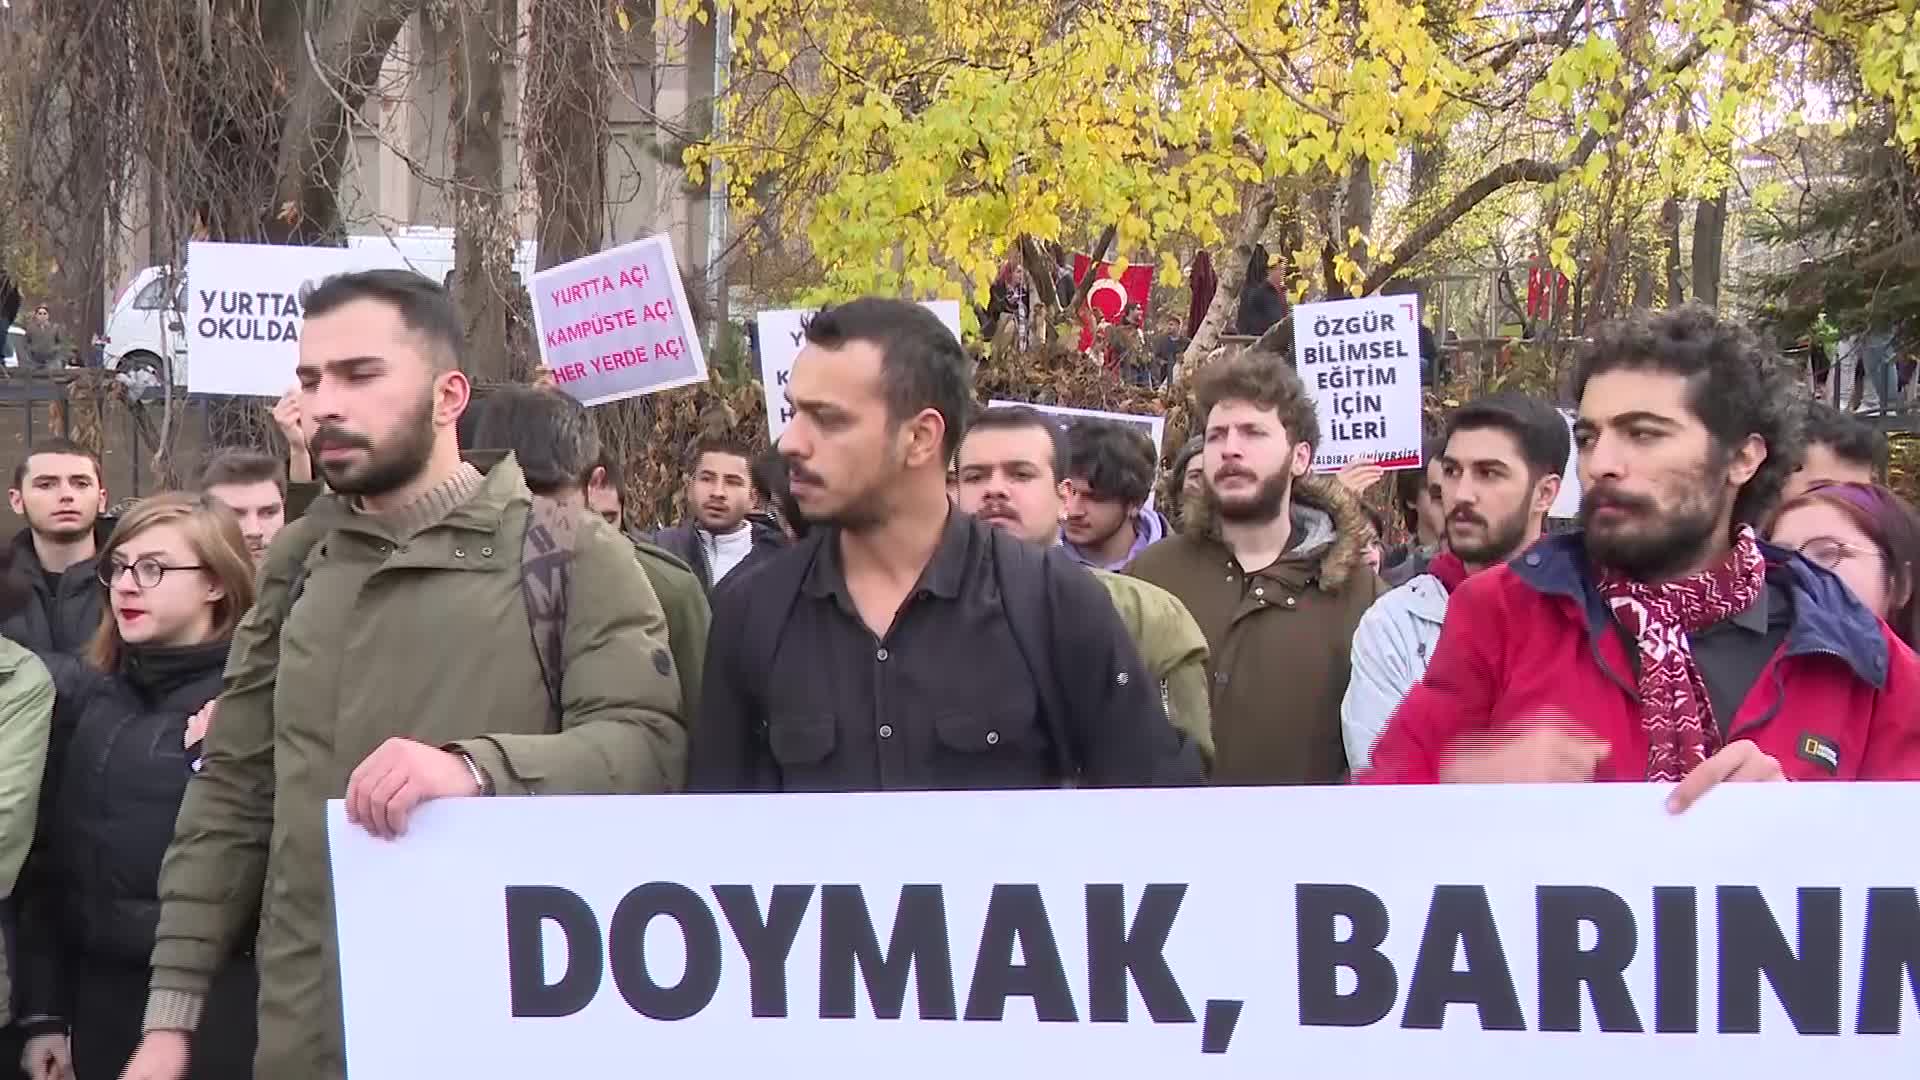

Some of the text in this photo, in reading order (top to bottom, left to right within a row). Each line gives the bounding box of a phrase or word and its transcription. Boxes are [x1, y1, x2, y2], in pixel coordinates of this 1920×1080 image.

[551, 264, 650, 307] YURTTA AÇ!
[200, 290, 298, 317] YURTTA
[198, 318, 298, 341] OKULDA
[546, 298, 674, 347] KAMPÜSTE AÇ!
[1313, 310, 1396, 337] ÖZGÜR
[551, 336, 687, 385] HER YERDE AÇ!
[1304, 339, 1409, 365] BİLİMSEL
[1317, 364, 1397, 390] EĞİTİM
[1332, 391, 1382, 419] İÇİN
[1330, 416, 1387, 441] İLERİ
[505, 881, 1244, 1054] DOYMAK,
